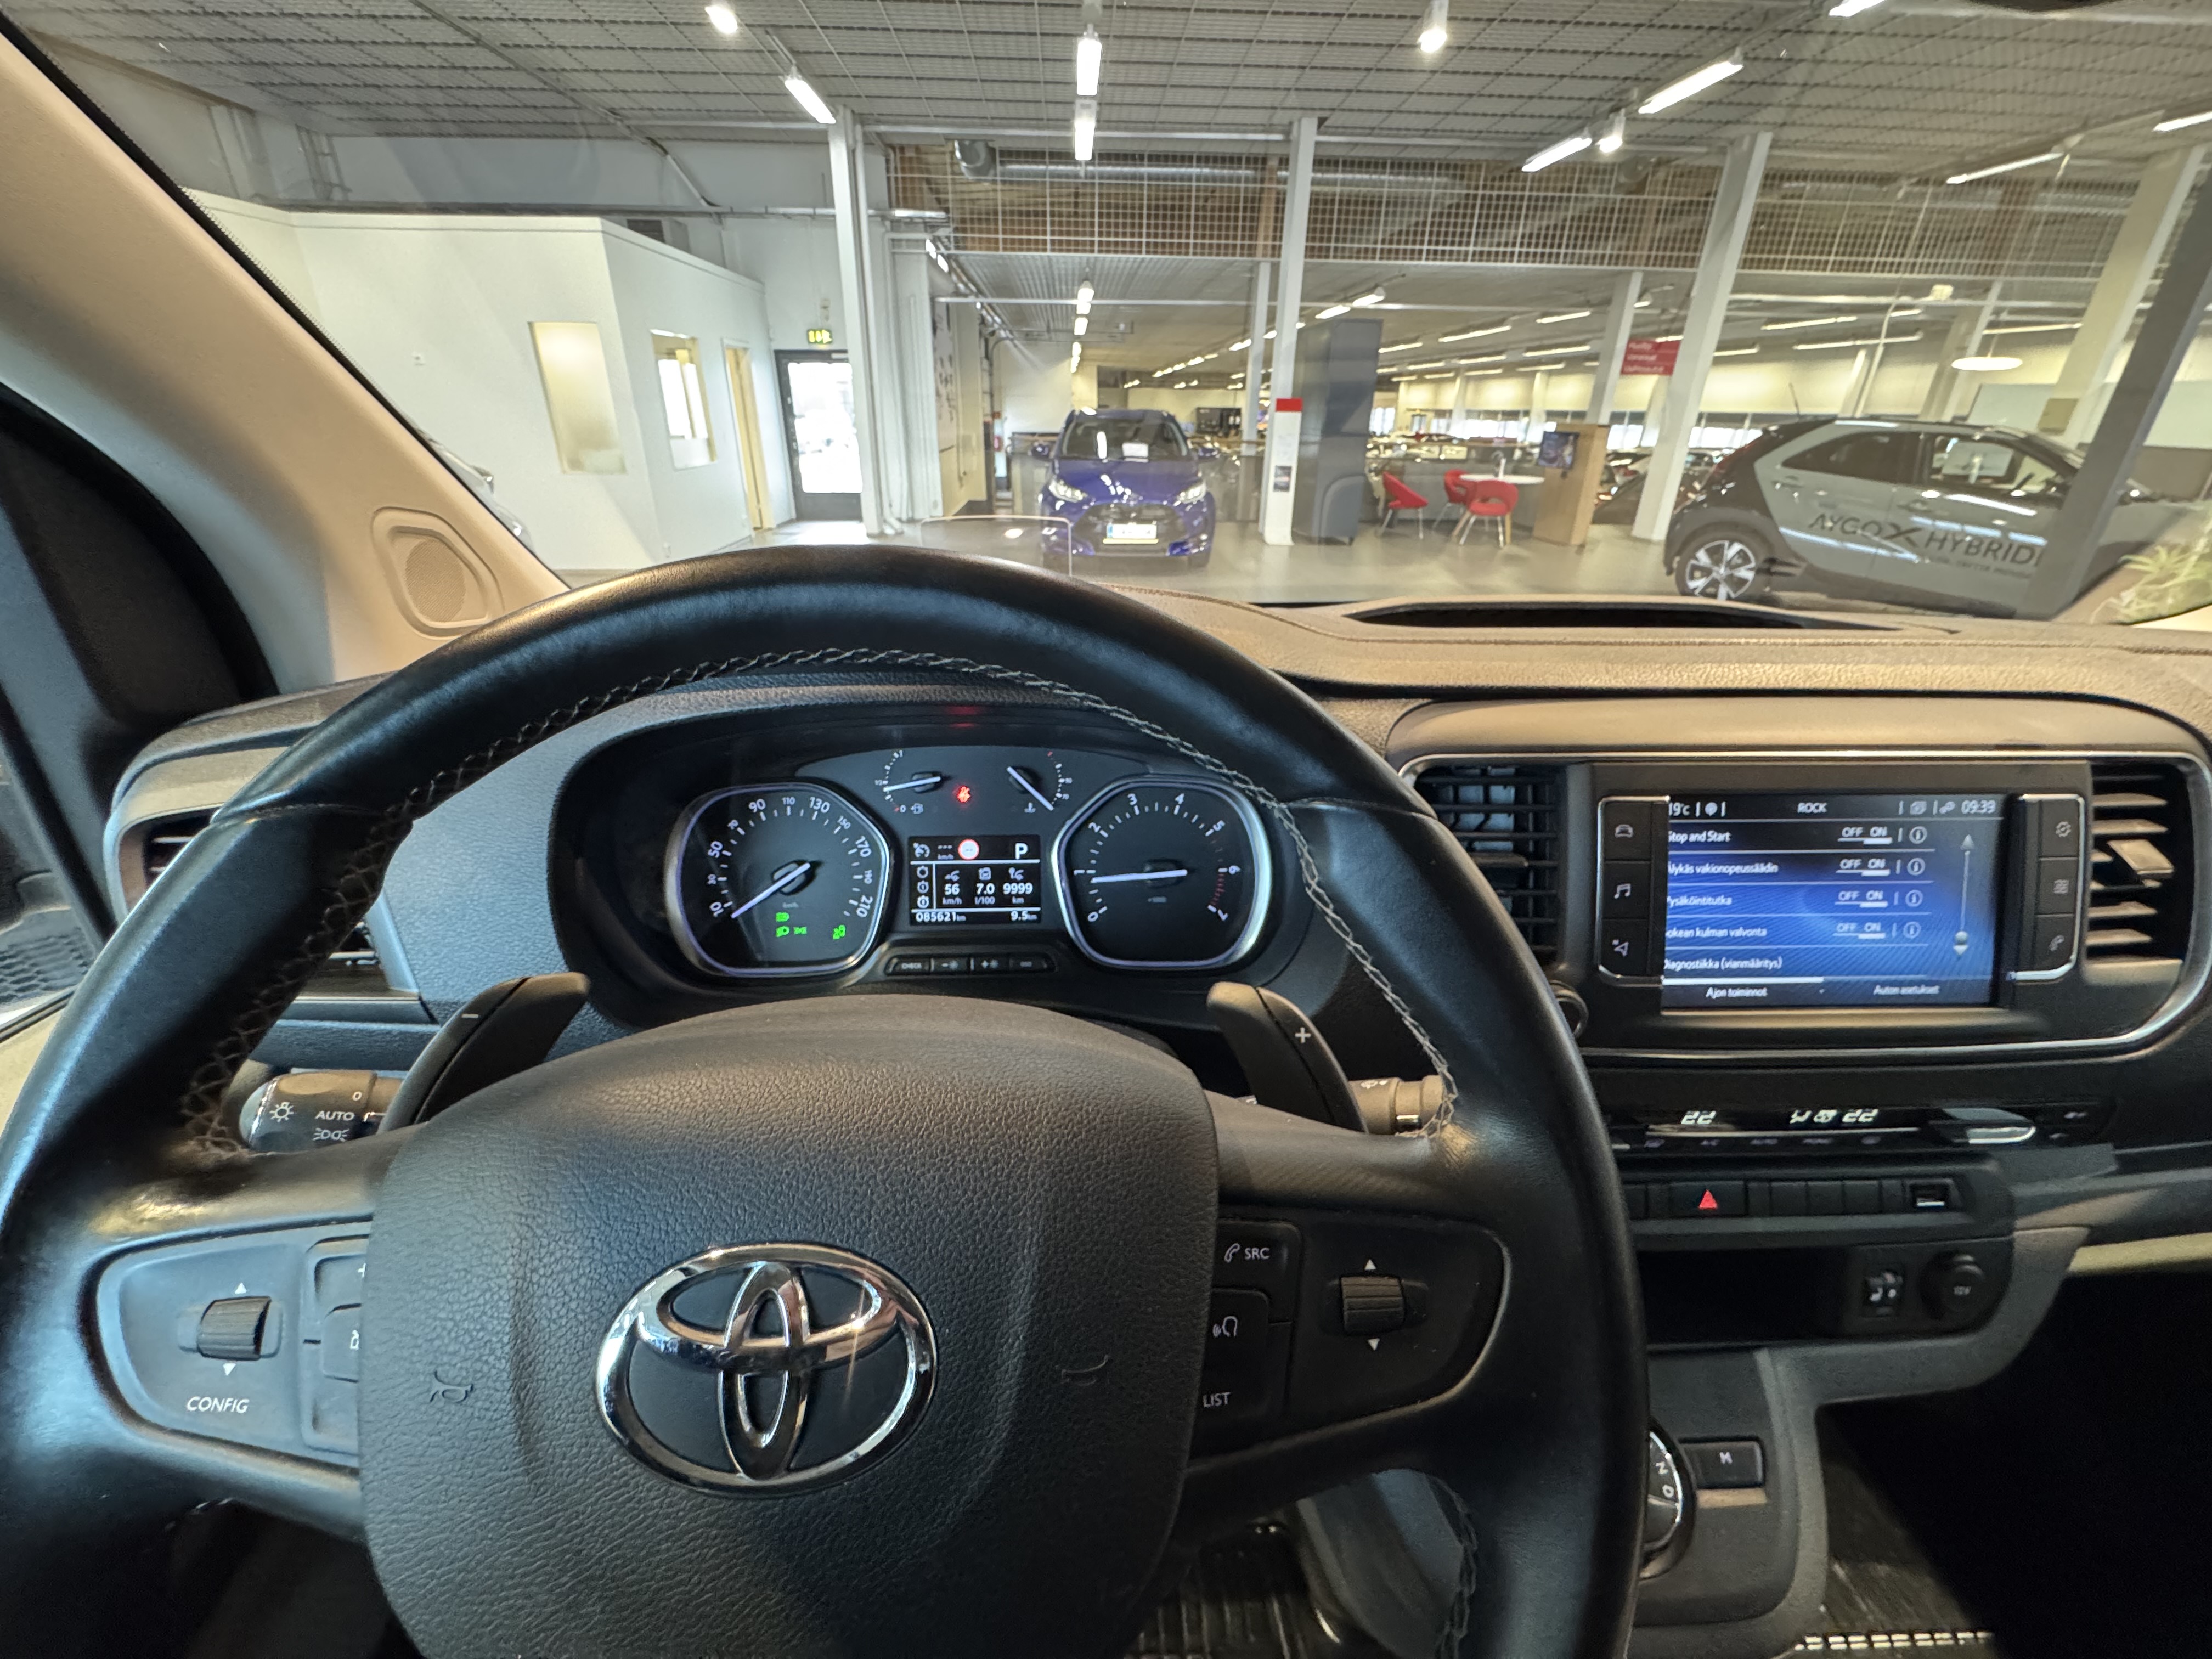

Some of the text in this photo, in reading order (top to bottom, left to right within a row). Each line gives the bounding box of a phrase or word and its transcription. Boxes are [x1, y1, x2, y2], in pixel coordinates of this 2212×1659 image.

[1127, 793, 1138, 805] 3
[1175, 793, 1185, 805] 4
[749, 799, 766, 813] 90
[810, 797, 831, 814] 130
[1797, 802, 1827, 814] ROCK
[1961, 799, 1996, 814] 09:39
[1088, 822, 1101, 833] 2
[1212, 820, 1226, 832] 5
[1842, 826, 1888, 837] OFF ON
[1689, 831, 1706, 842] and
[1707, 830, 1732, 843] Start
[708, 841, 723, 859] 50
[855, 836, 872, 857] 170
[1015, 843, 1028, 860] P
[1840, 858, 1886, 869] OFF ON
[1229, 865, 1242, 875] 6
[944, 882, 1033, 895] 56 7.0 9999
[942, 896, 962, 905] km/h
[1012, 896, 1024, 904] km
[1667, 895, 1733, 907] ysäköintitutka
[1838, 890, 1884, 900] OFF ON
[710, 901, 724, 917] 10
[856, 895, 873, 918] 210
[1087, 911, 1099, 922] 0
[1217, 909, 1229, 921] 7
[1665, 927, 1768, 938] okean kulman valvonta
[1836, 922, 1882, 932] OFF ON
[315, 1110, 355, 1121] AUTO
[1680, 1108, 1879, 1125] 22 22
[1244, 1248, 1270, 1260] SRC
[186, 1396, 250, 1413] CONFIG
[1203, 1392, 1231, 1408] LIST
